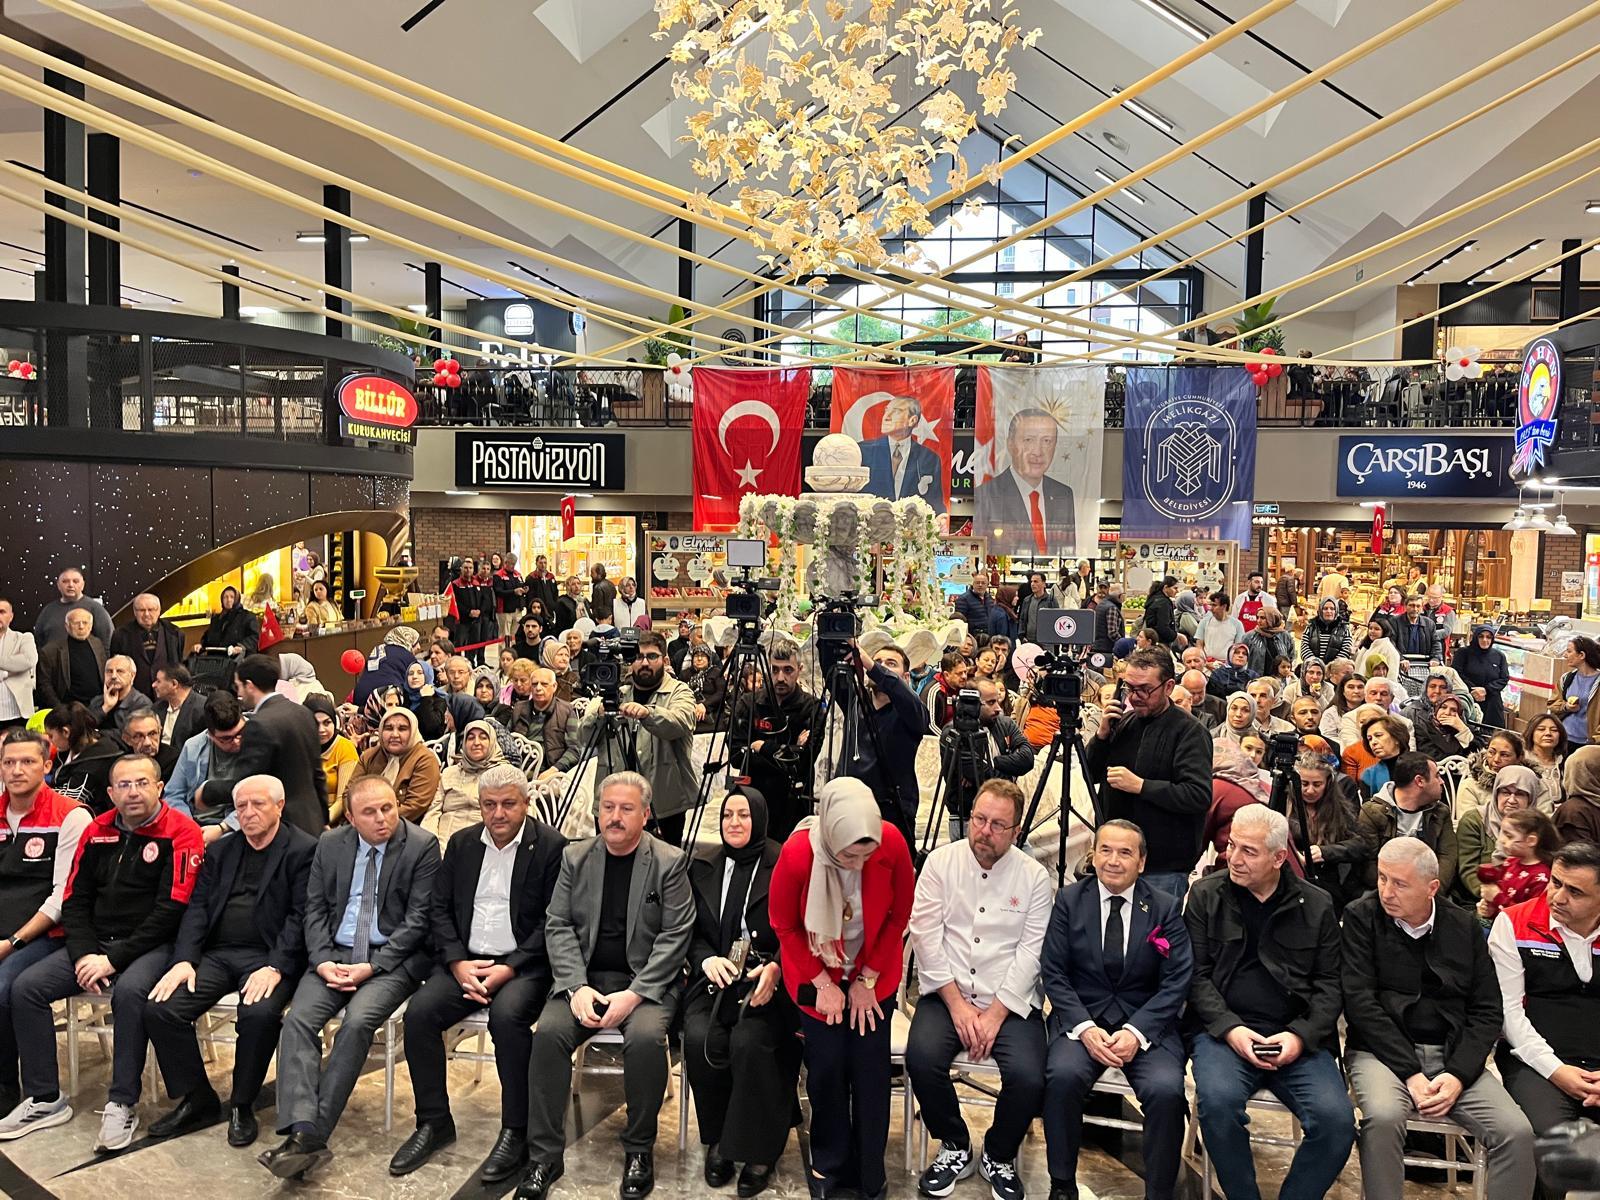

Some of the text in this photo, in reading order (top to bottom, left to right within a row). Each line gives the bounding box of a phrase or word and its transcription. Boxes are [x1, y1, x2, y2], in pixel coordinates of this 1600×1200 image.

[347, 422, 411, 443] KURUKAHVECİSİ
[1407, 480, 1427, 489] 1946
[1163, 496, 1213, 511] BELEDİYESİ
